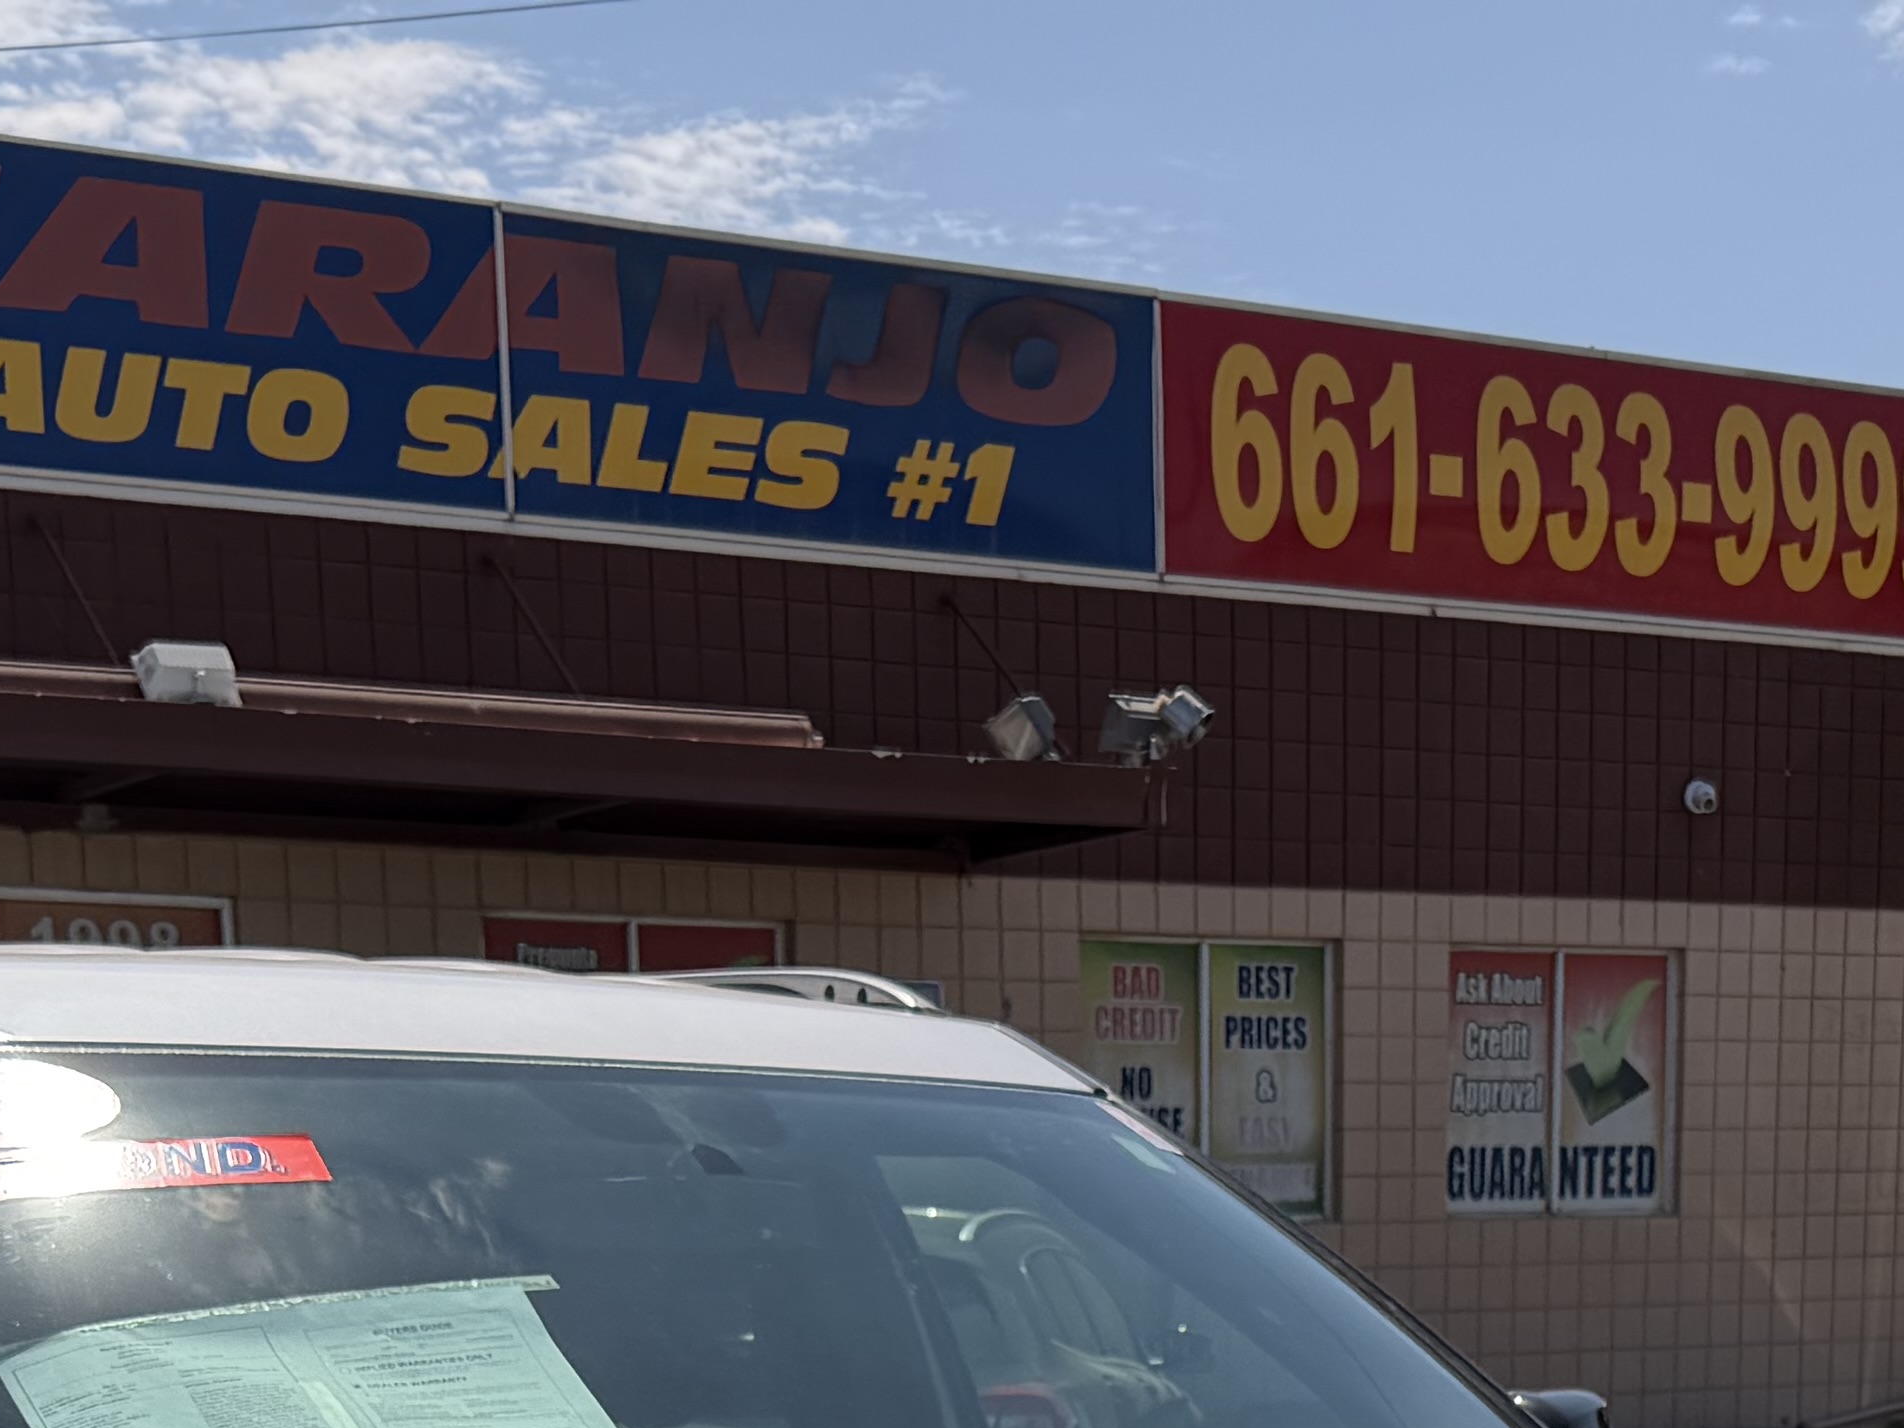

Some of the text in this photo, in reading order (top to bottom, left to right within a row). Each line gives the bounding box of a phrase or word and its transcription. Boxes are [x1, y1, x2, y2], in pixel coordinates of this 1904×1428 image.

[397, 384, 849, 511] SALES
[886, 439, 1015, 526] #1
[1112, 965, 1161, 998] BAD
[1237, 965, 1294, 999] BEST
[1456, 972, 1543, 1006] Ask About
[1096, 1006, 1180, 1041] CREDIT
[1225, 1015, 1308, 1050] PRICES
[1464, 1021, 1531, 1060] Credit
[1120, 1066, 1152, 1099] NO
[1451, 1073, 1544, 1116] Approval
[1448, 1145, 1656, 1200] GUARANTEED
